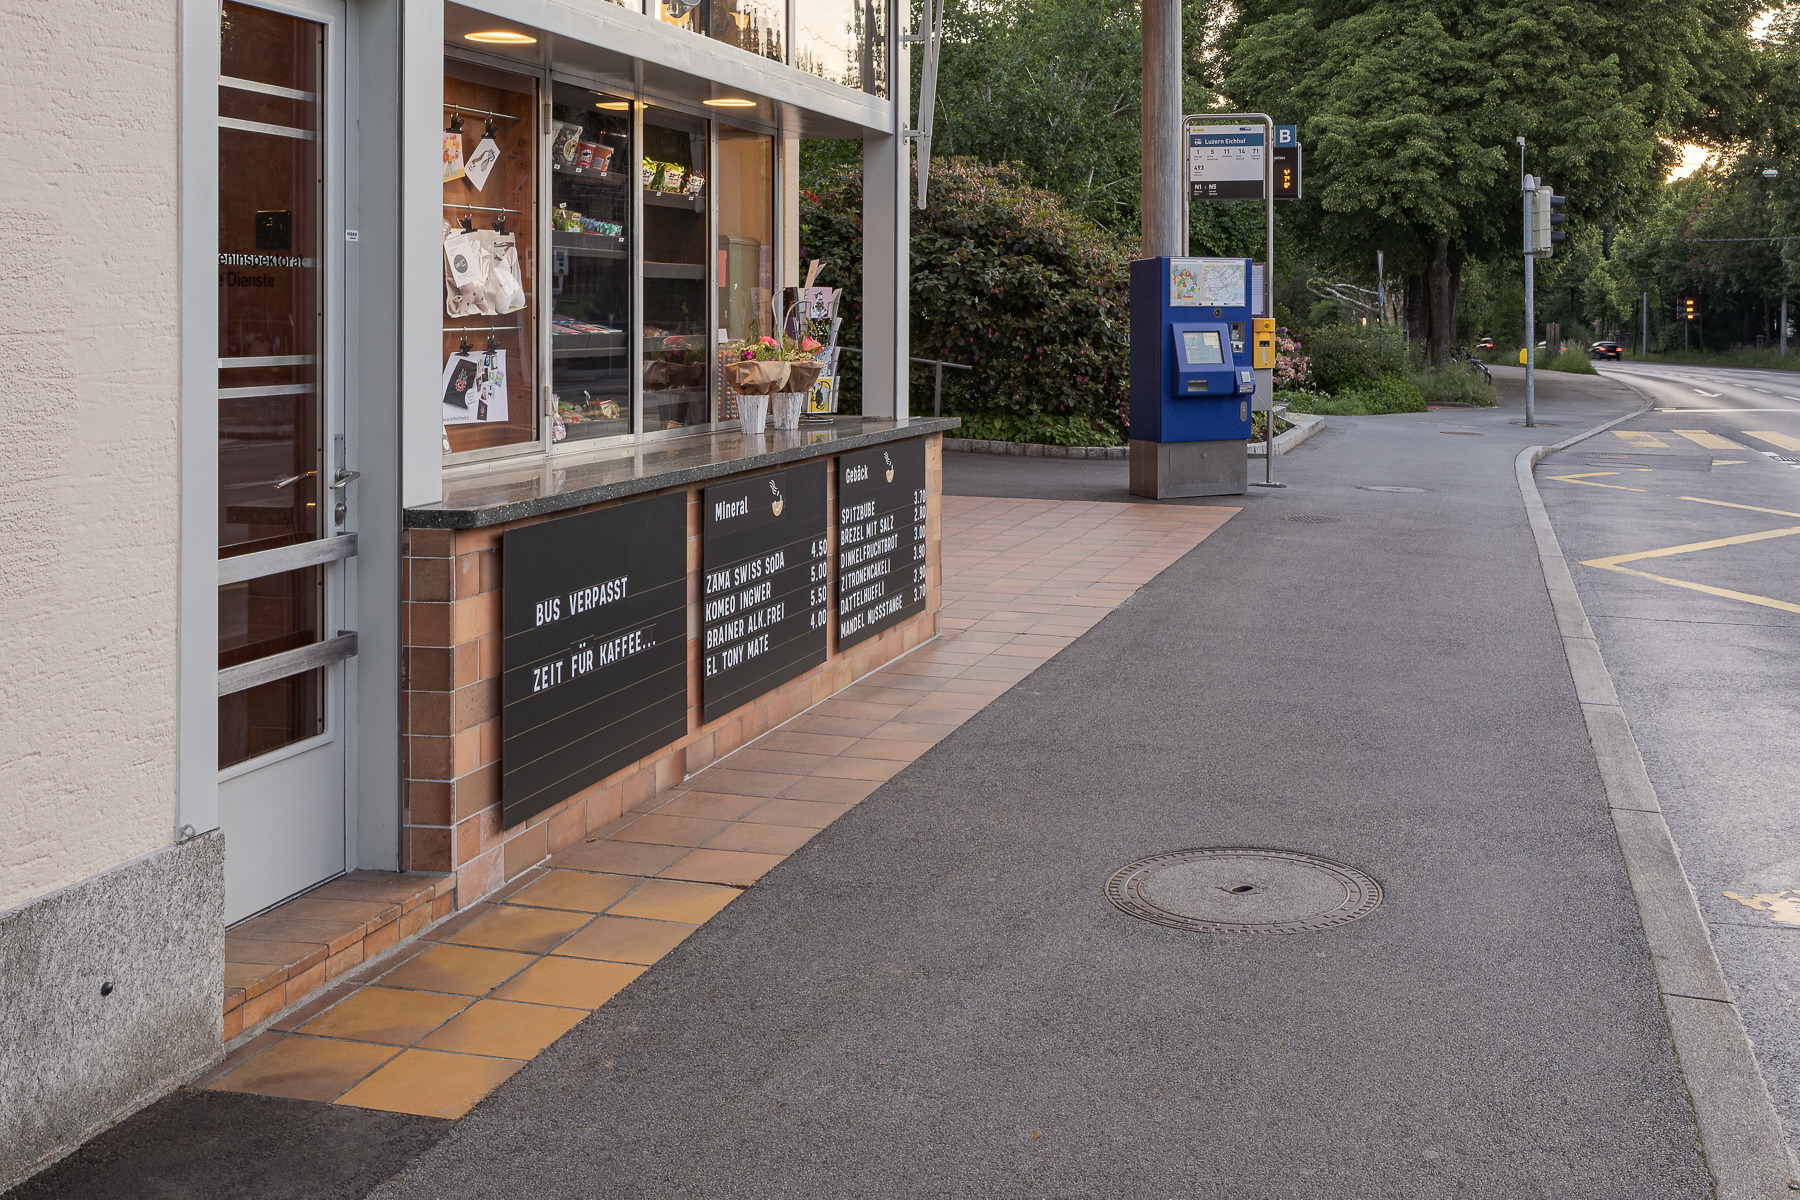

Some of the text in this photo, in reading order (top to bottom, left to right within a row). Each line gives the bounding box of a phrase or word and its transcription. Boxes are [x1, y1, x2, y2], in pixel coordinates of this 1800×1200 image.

[1225, 137, 1246, 145] Eichhof
[1279, 129, 1291, 144] B
[227, 271, 275, 288] Dienste
[845, 464, 868, 484] Gebäck
[715, 496, 748, 522] Mineral
[841, 501, 875, 524] SPITZBUBE
[840, 525, 864, 546] BREZEL
[866, 521, 878, 539] MIT
[879, 515, 894, 534] SALZ
[706, 538, 827, 594] ZAMA SWISS SODA 4.50
[840, 534, 898, 569] DINKELFRUCHTBROT
[705, 561, 827, 622] KOMEO INGWER 5.00
[840, 558, 891, 593] ZITRONENCAKELI
[536, 577, 628, 627] BUS VERPASST
[840, 580, 885, 615] DATTELHUEFLI
[706, 585, 827, 649] BRAINER ALK.FREI 5.50
[840, 611, 865, 639] MANDEL
[706, 608, 827, 677] EL TONY MATE 4.00
[533, 630, 656, 693] ZEIT FÜR KAFFEE...
